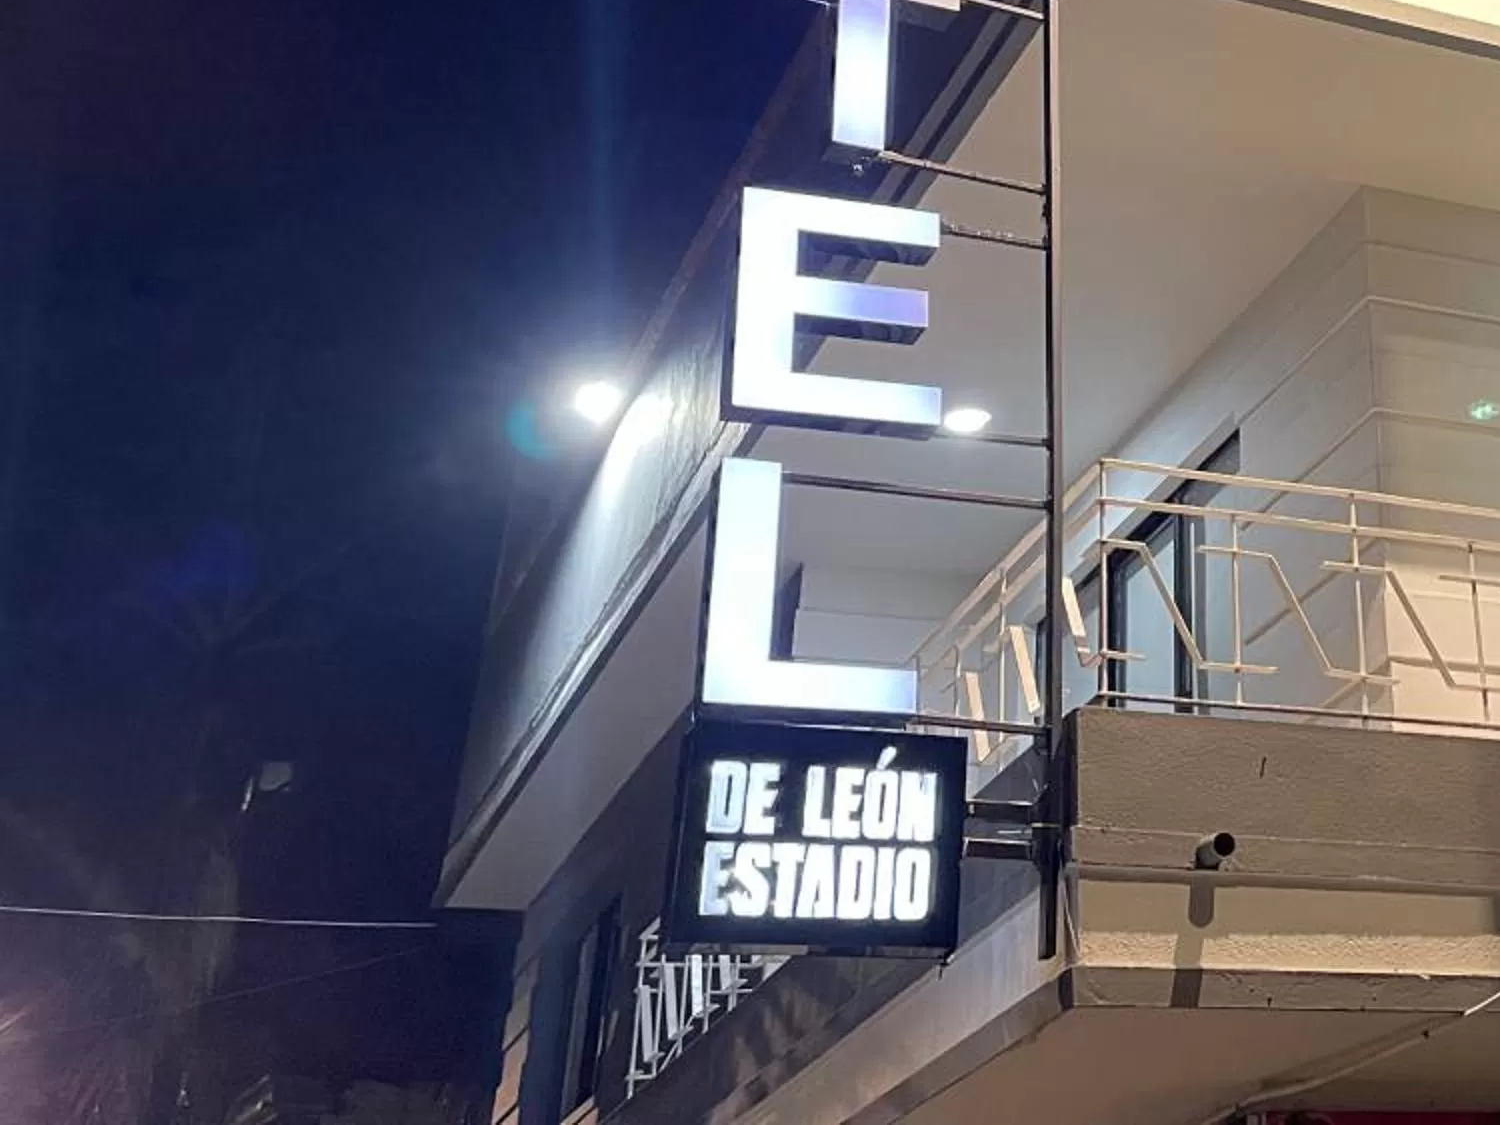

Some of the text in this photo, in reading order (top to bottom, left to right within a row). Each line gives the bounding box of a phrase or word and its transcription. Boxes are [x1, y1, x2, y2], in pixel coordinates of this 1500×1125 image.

[705, 746, 938, 842] DE LEÓN
[699, 841, 932, 921] ESTADIO
